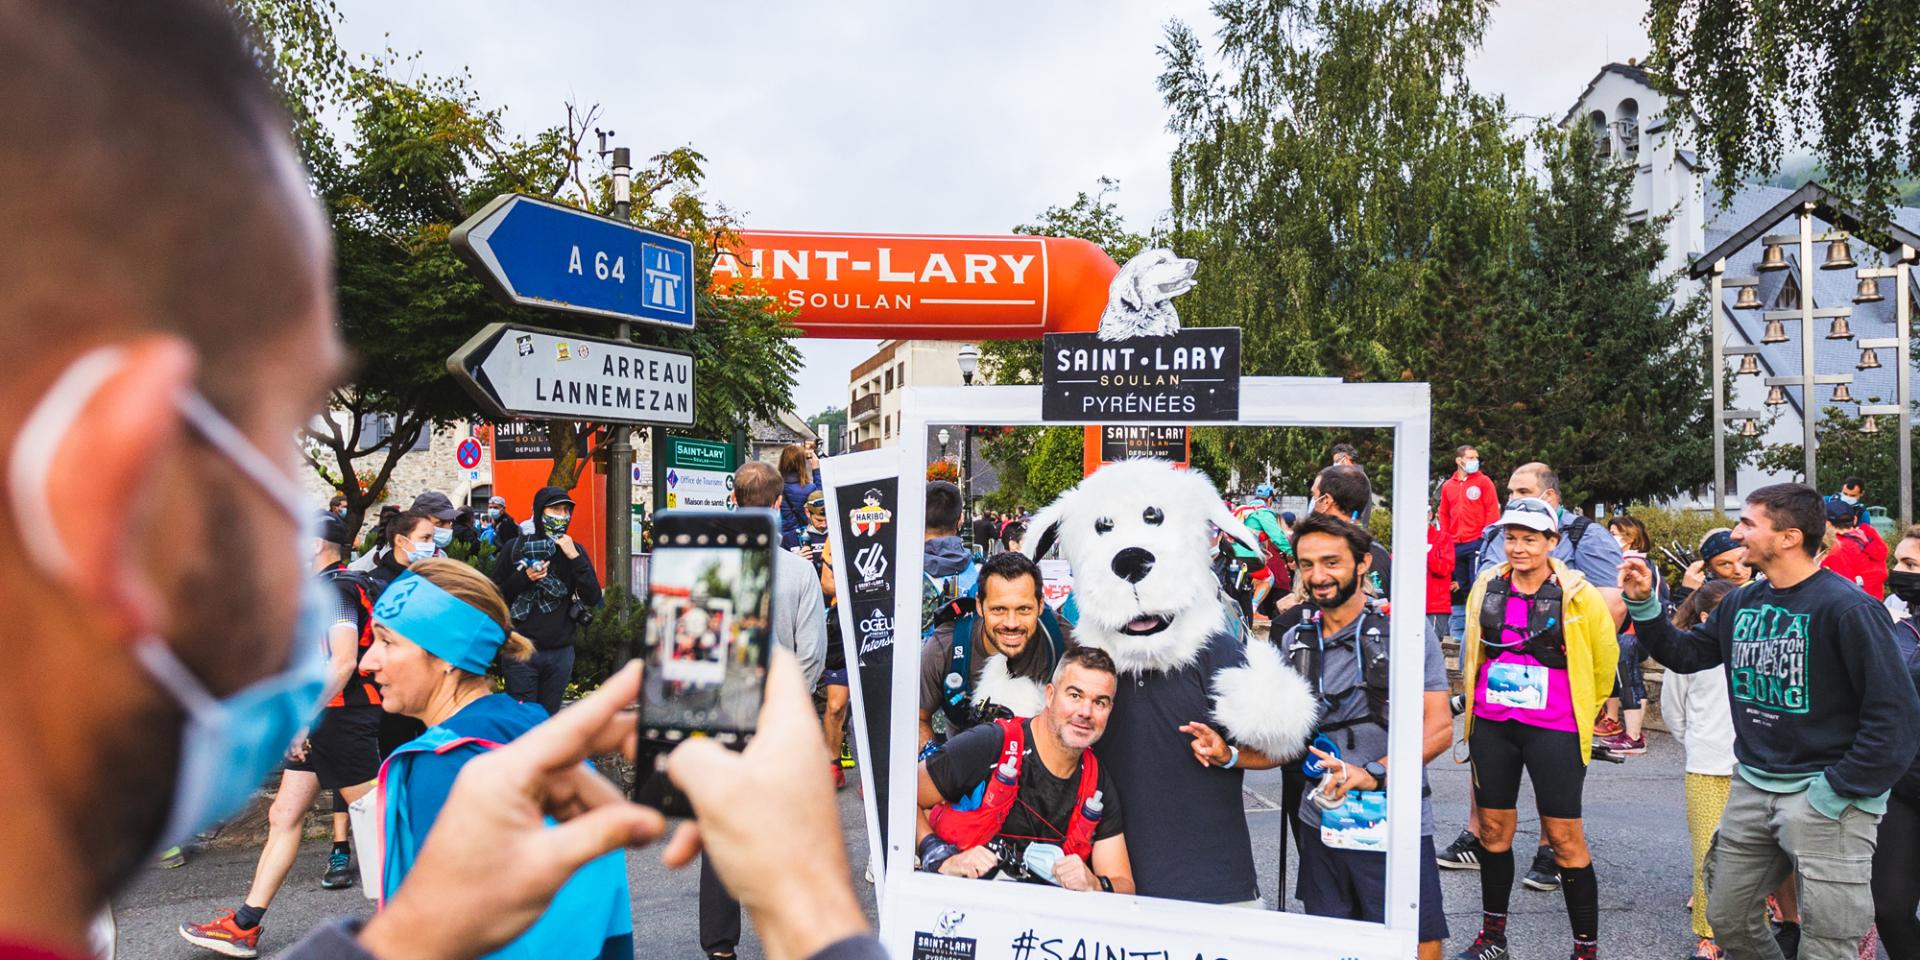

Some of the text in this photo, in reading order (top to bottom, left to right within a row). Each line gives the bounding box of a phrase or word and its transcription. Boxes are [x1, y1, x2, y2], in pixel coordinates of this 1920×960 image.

[568, 245, 625, 284] A 64
[710, 247, 1035, 284] AINT-LARY
[787, 289, 911, 310] SOULAN
[602, 354, 687, 384] ARREAU
[1100, 374, 1179, 386] SOULAN
[536, 377, 687, 413] LANNEMEZAN
[1083, 392, 1196, 413] PYRÉNÉES
[684, 497, 725, 507] Maison de santé
[856, 512, 884, 522] HARIBO
[860, 617, 895, 633] OGEU
[1733, 605, 1804, 641] BILLA
[1731, 667, 1803, 707] BONG
